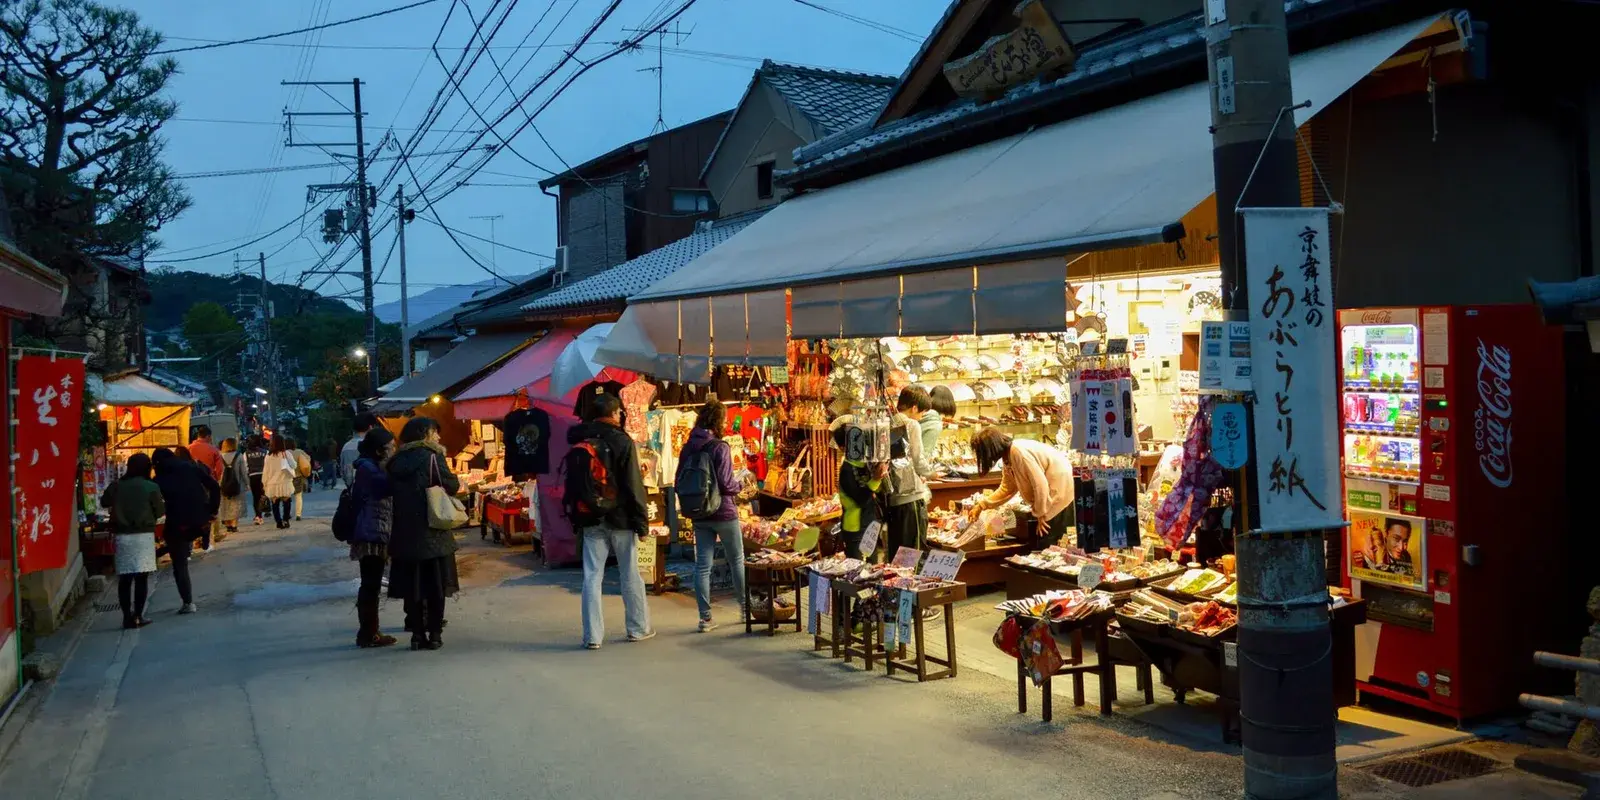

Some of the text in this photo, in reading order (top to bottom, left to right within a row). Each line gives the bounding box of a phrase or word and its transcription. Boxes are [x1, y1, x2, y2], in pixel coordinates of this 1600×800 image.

[1298, 225, 1325, 328] 京舞妓の
[1232, 326, 1250, 335] VIS
[60, 373, 74, 408] 本家
[1261, 264, 1328, 511] あぶらとり紙
